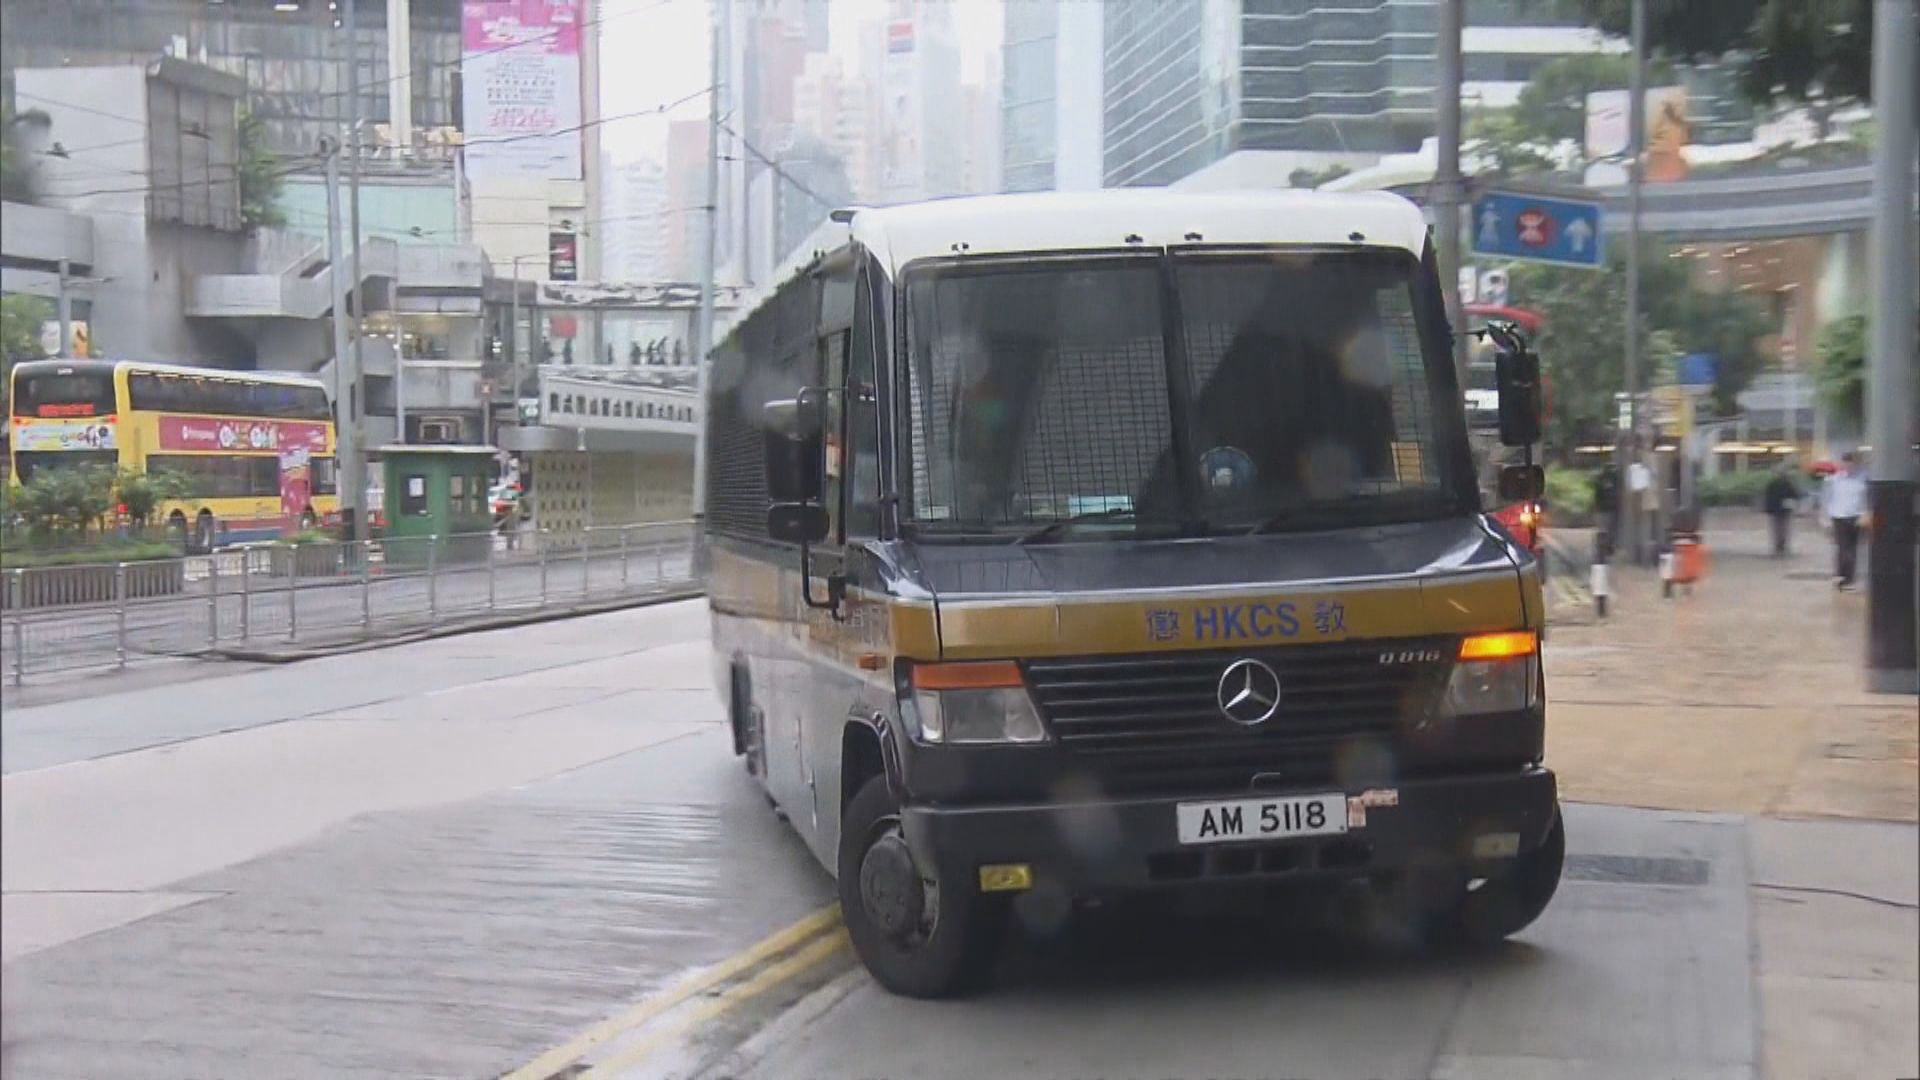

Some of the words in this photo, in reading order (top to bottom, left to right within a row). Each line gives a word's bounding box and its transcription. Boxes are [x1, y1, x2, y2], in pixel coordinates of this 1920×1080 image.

[1147, 608, 1181, 641] 懲
[1194, 602, 1299, 641] HKCS
[1314, 600, 1347, 633] 教
[1199, 805, 1244, 838] AM
[1260, 801, 1326, 833] 5118
